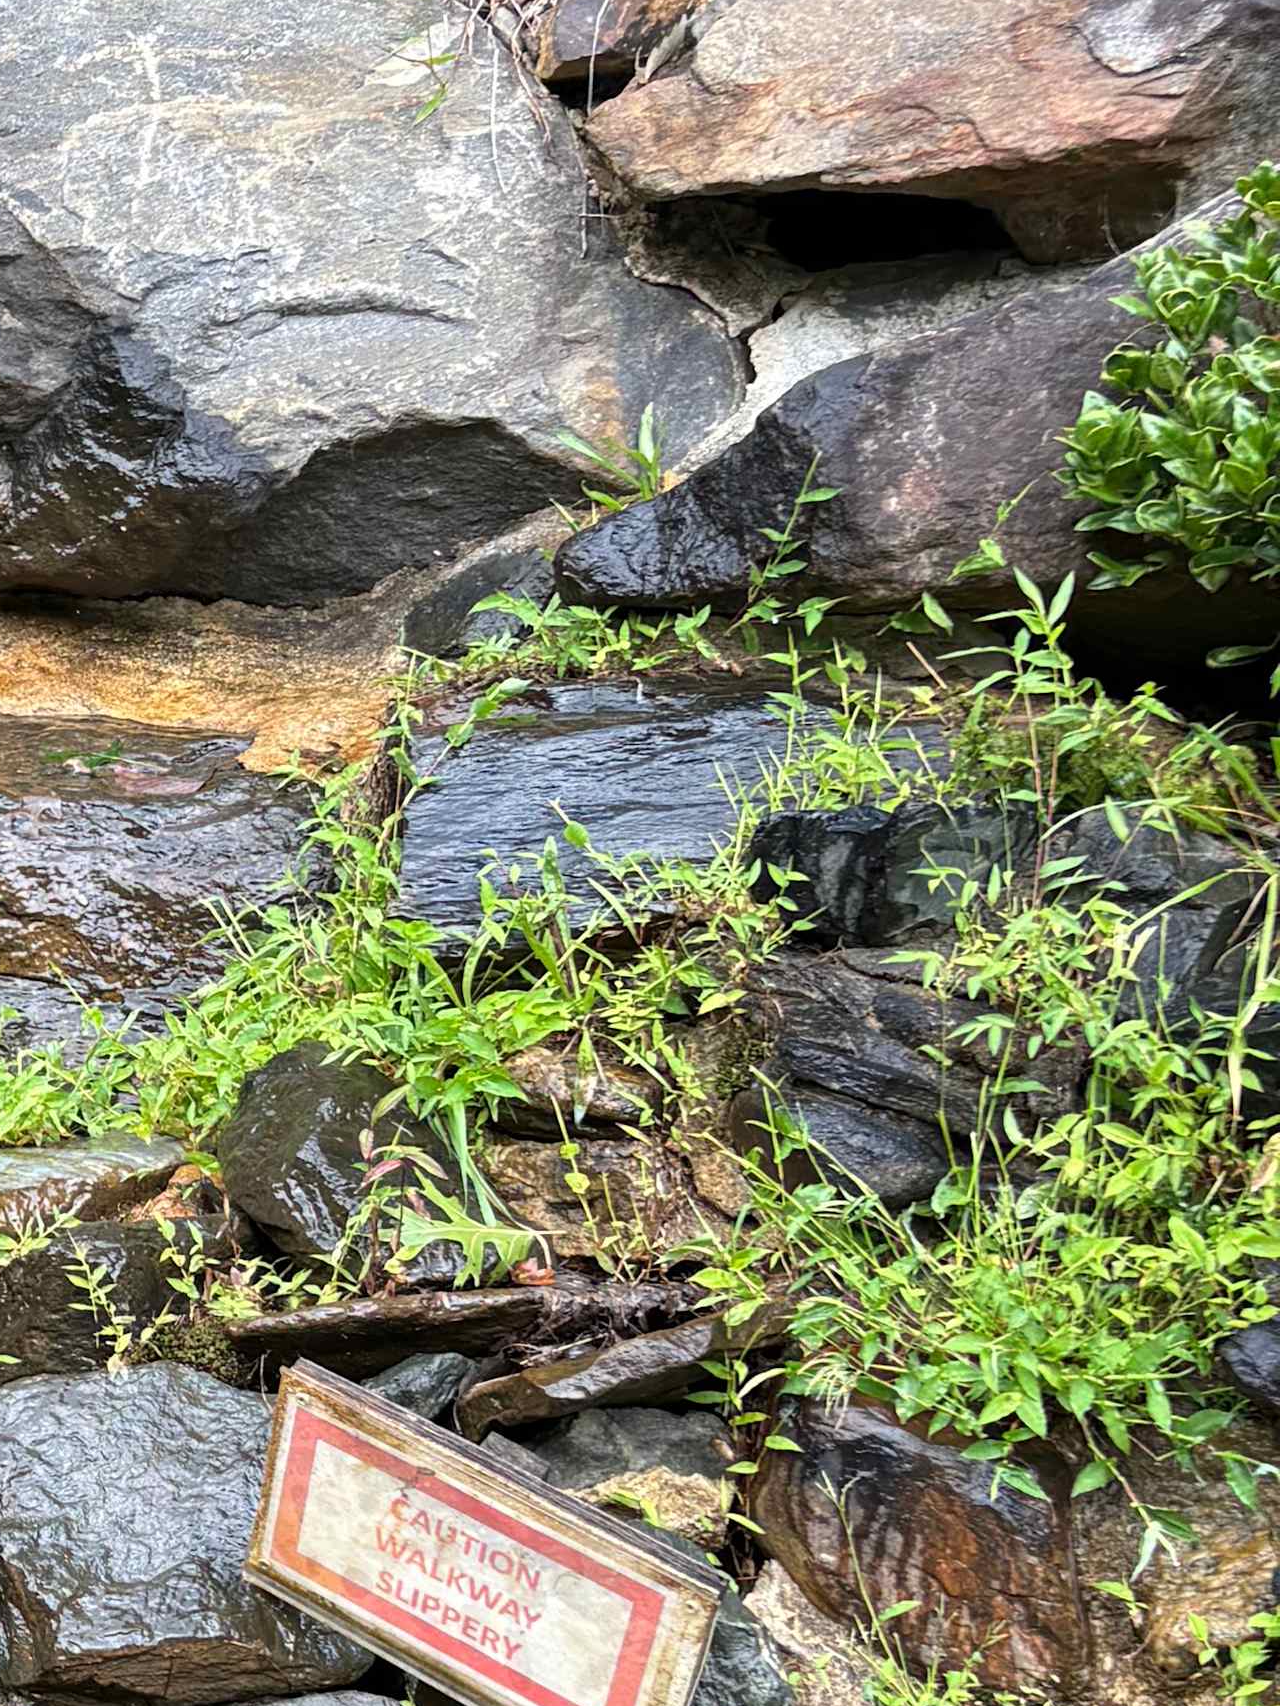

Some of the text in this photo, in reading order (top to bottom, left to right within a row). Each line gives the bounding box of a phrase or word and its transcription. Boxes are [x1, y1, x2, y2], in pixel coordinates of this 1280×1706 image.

[375, 1525, 543, 1631] WALKWAY
[387, 1496, 541, 1592] CAUTION
[376, 1570, 524, 1662] SLIPPERY
